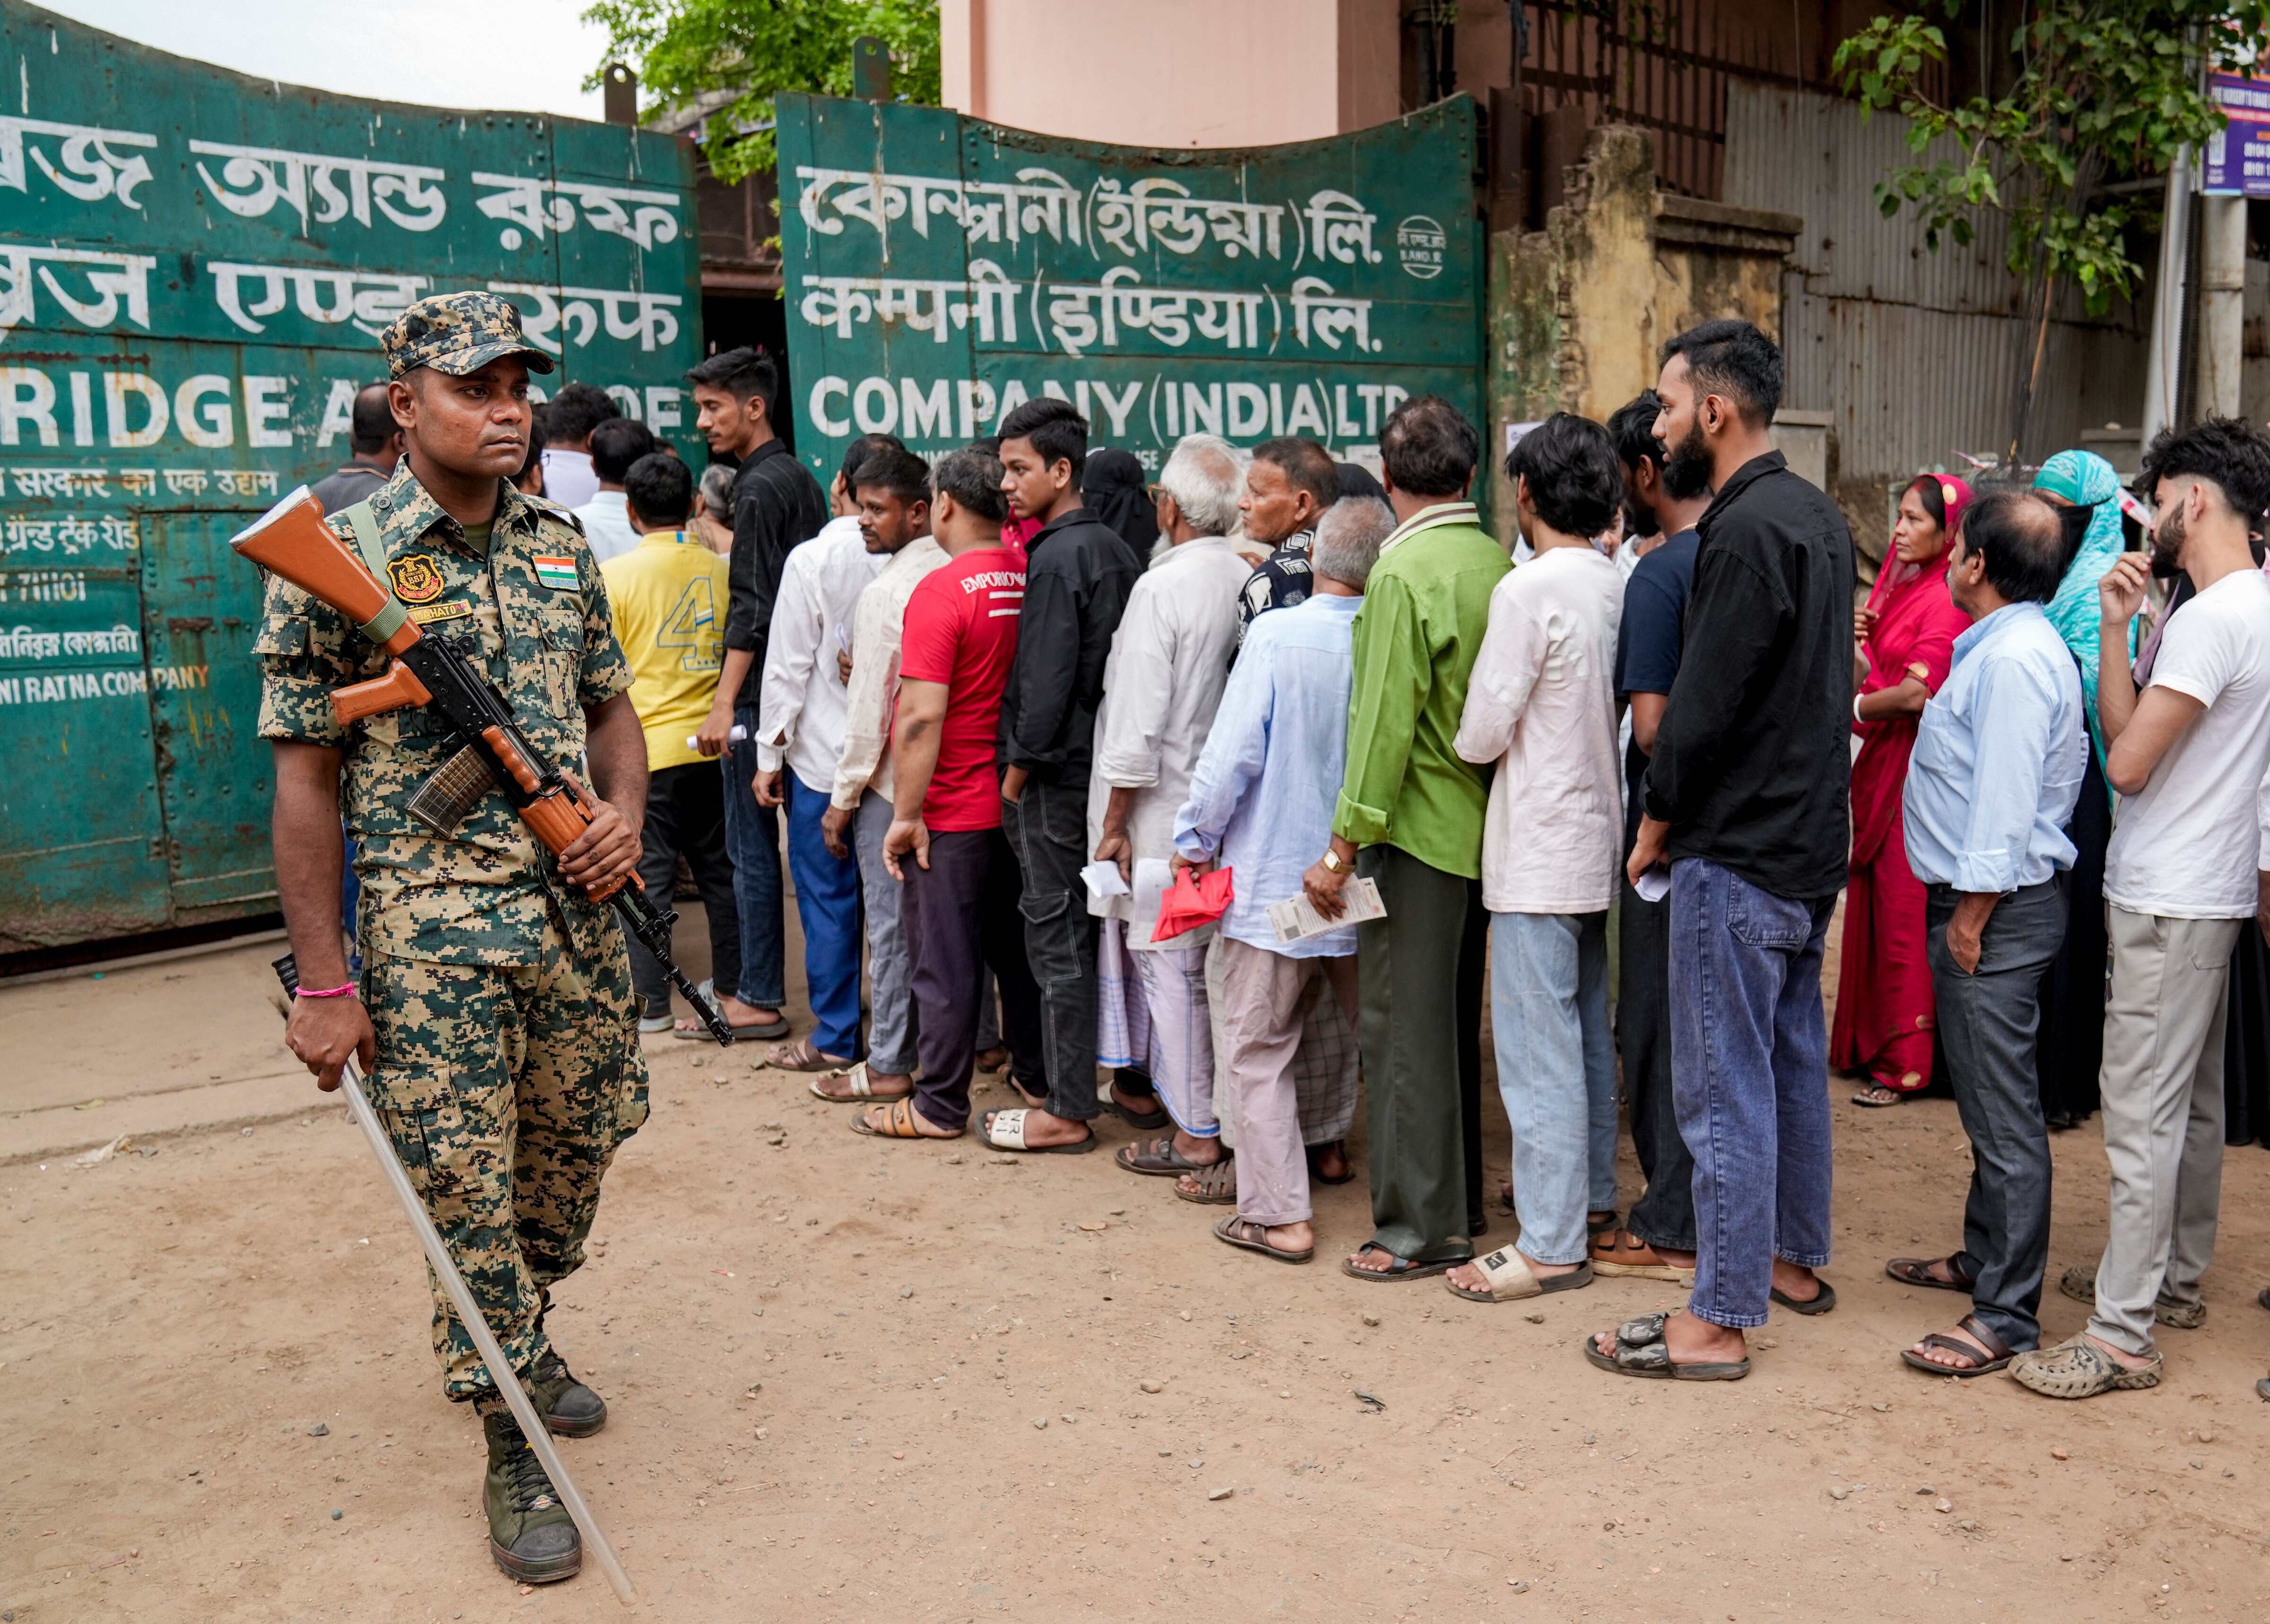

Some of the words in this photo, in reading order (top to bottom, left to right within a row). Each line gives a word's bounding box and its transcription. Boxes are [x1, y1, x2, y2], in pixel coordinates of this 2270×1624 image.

[801, 258, 1022, 343] कम्पनी
[10, 467, 112, 498] सरकार
[120, 468, 156, 496] का
[163, 469, 208, 496] एक
[99, 513, 140, 550] रोड
[408, 574, 424, 584] BSF
[960, 571, 1015, 595] EMPORIO
[413, 605, 456, 621] MAHATO
[24, 673, 102, 703] RATNA
